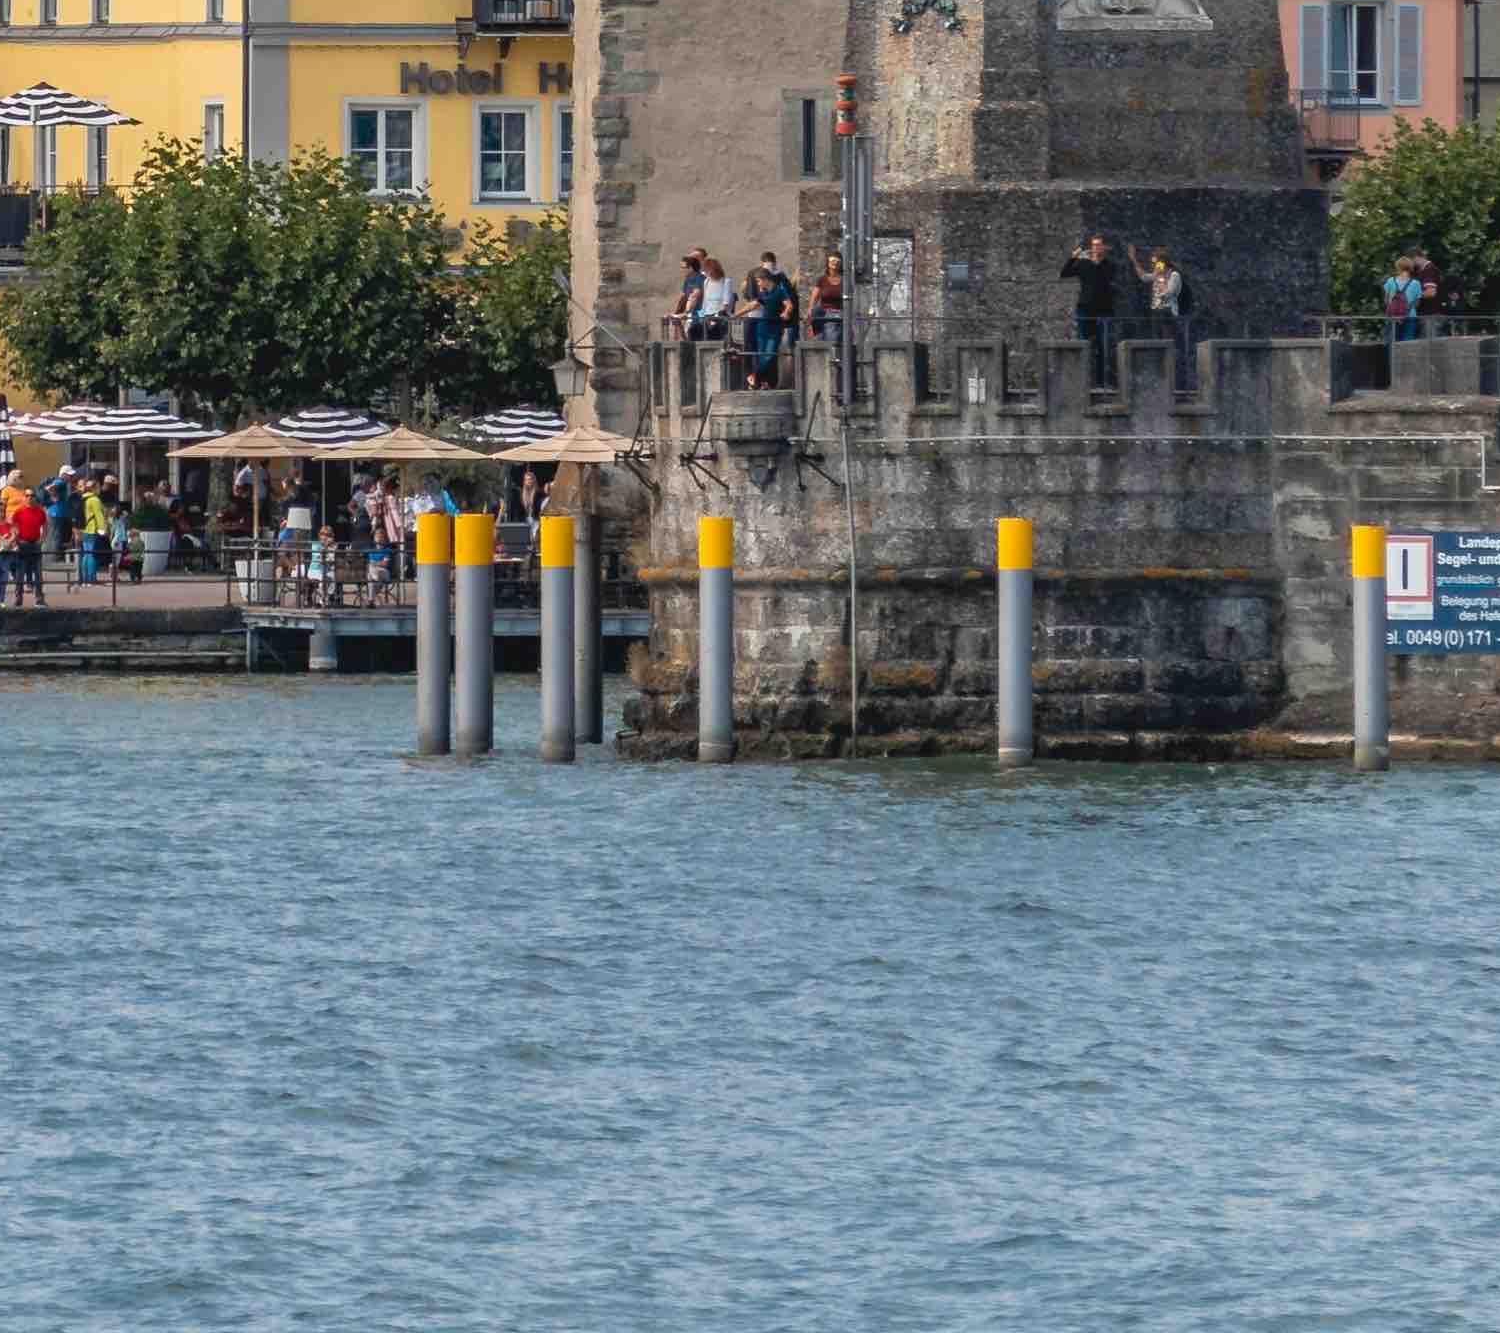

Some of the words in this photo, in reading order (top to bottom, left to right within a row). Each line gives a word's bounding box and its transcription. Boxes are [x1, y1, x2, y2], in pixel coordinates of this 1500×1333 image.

[400, 61, 504, 95] Hotel
[537, 61, 573, 95] H
[1437, 552, 1477, 567] Segel-
[1385, 630, 1402, 645] el.
